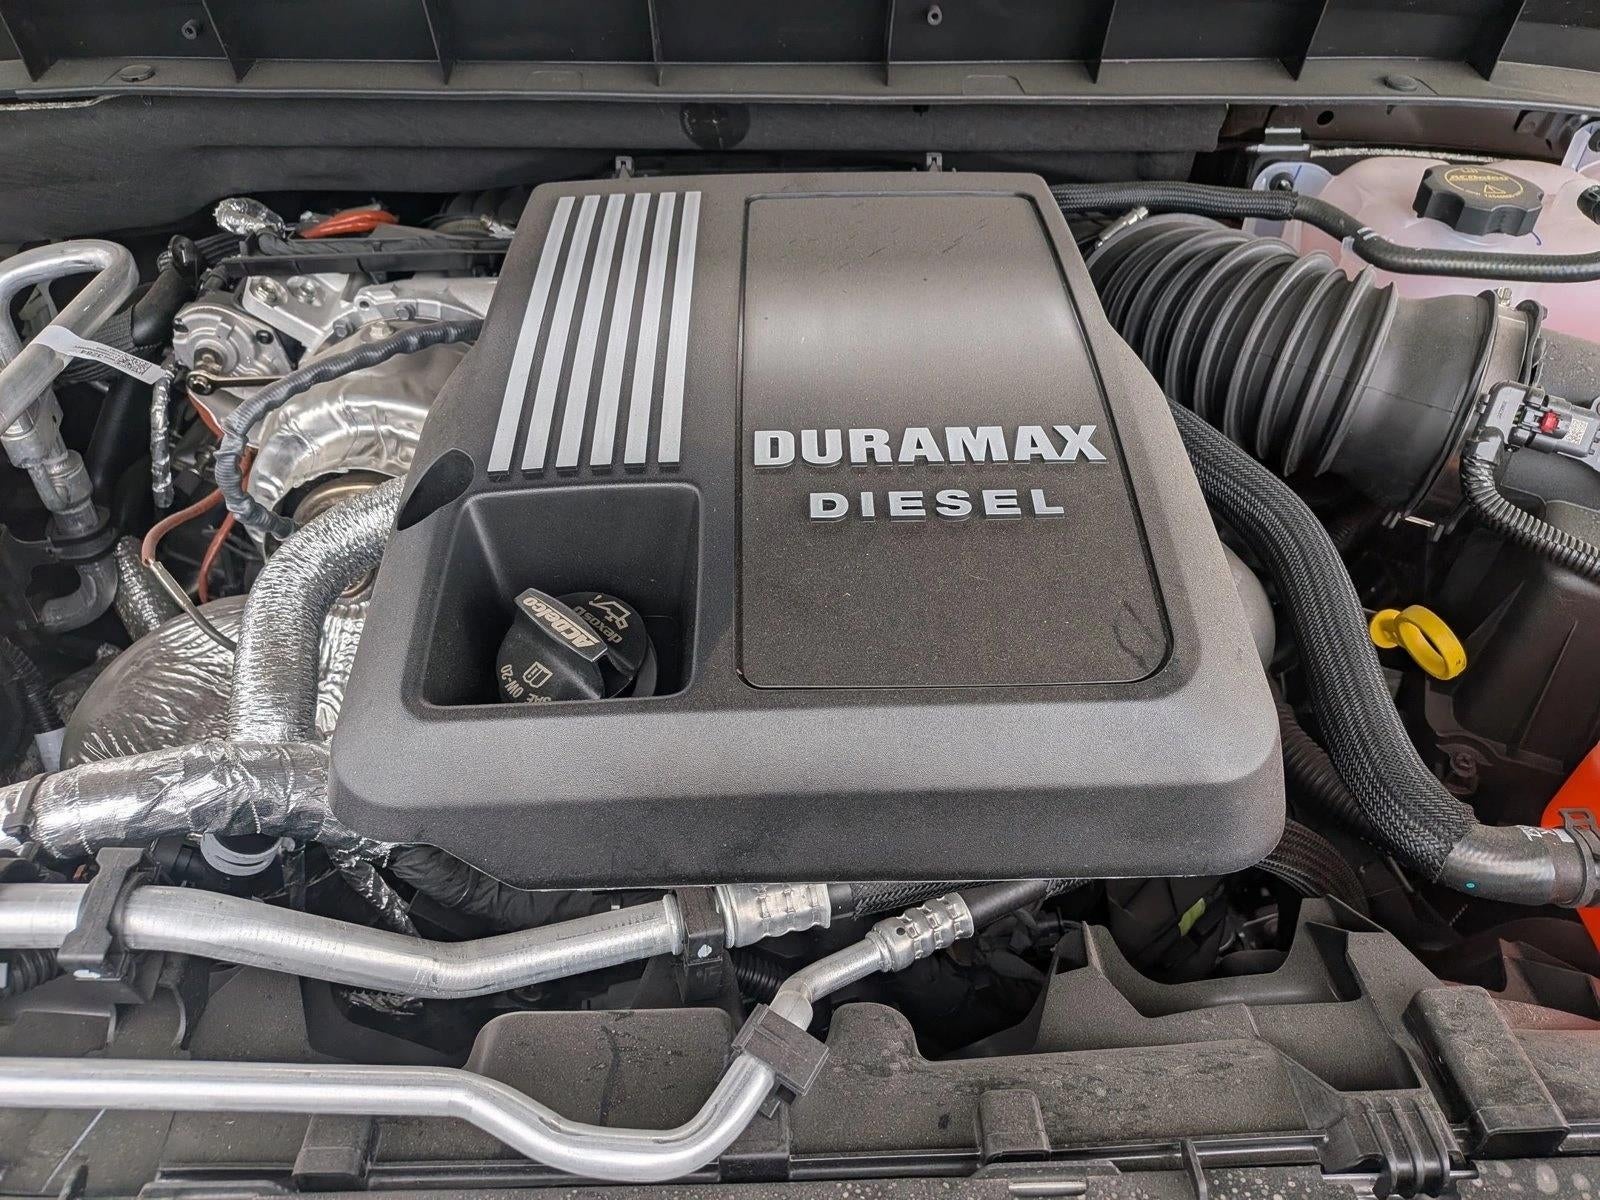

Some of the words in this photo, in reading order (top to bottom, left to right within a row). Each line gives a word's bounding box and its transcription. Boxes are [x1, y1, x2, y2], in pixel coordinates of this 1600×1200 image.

[754, 425, 1108, 466] DURAMAX
[809, 489, 1065, 521] DIESEL
[522, 597, 597, 648] ACDelco
[500, 664, 524, 698] 0W-20
[526, 693, 552, 704] SAE
